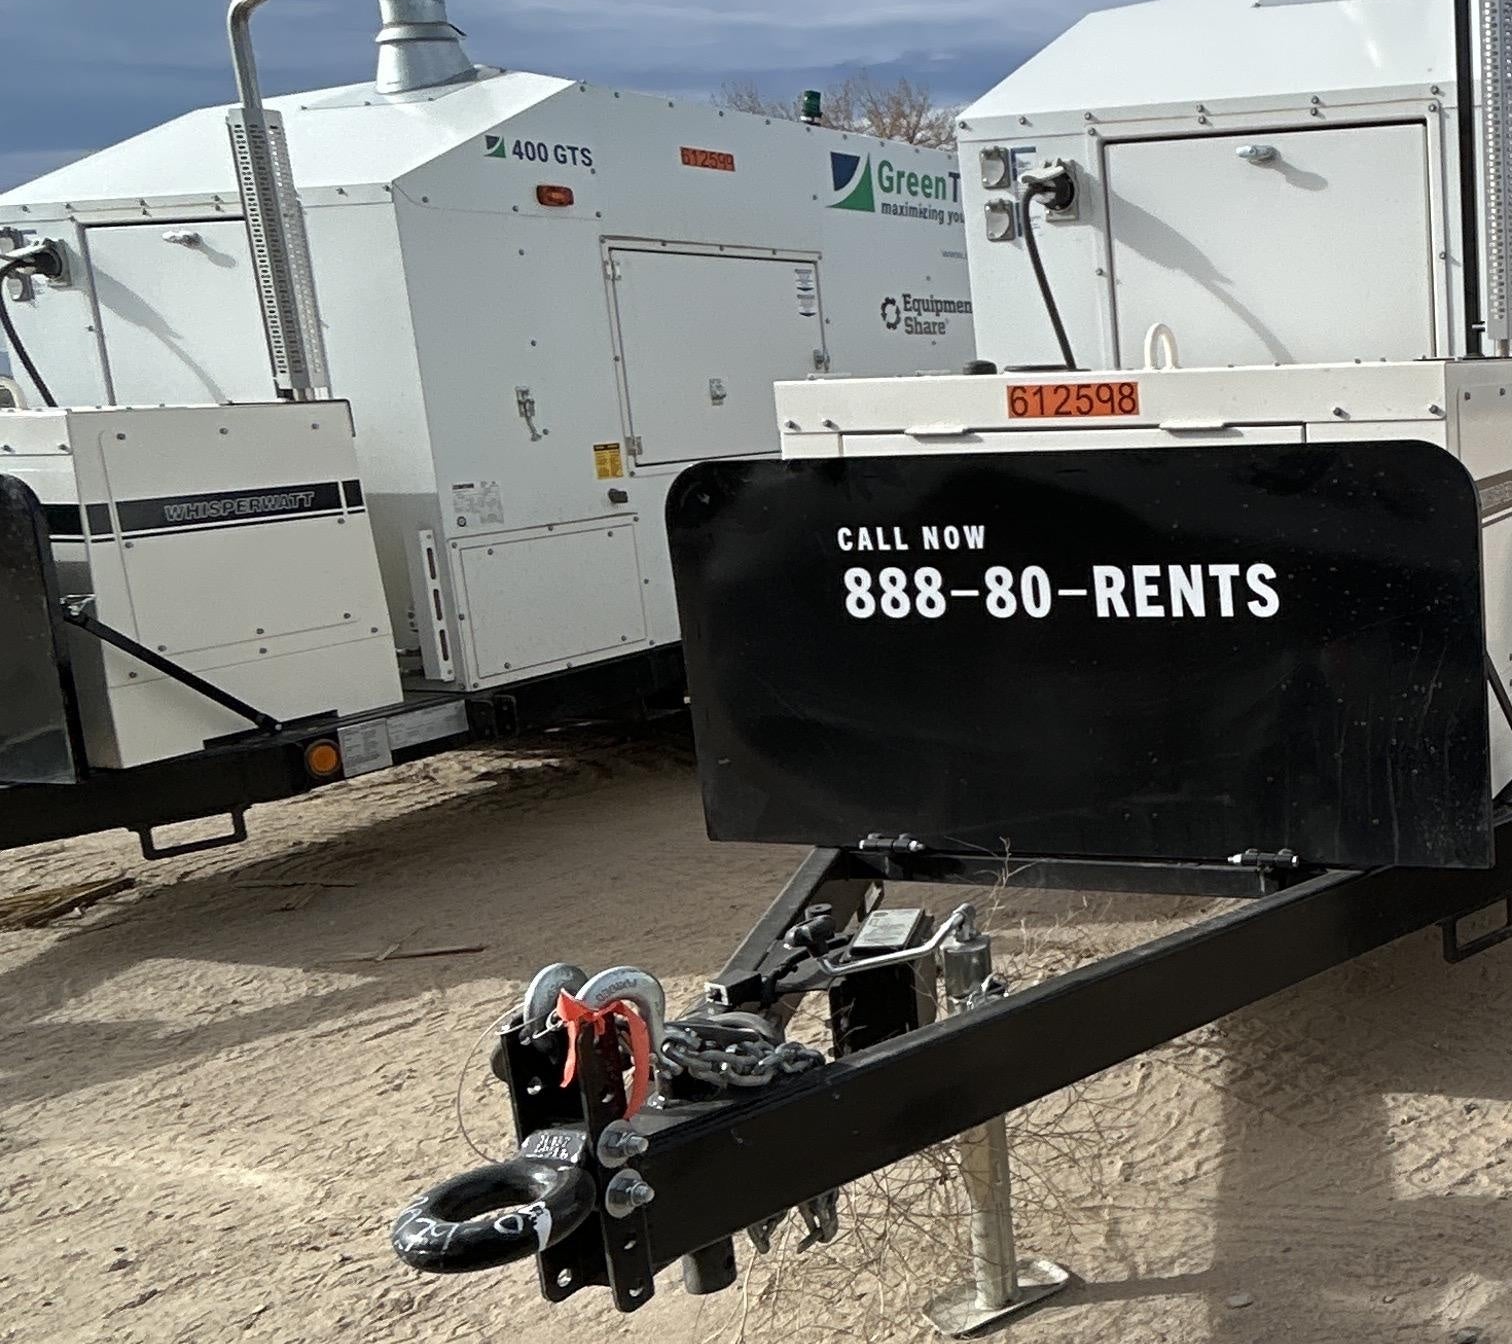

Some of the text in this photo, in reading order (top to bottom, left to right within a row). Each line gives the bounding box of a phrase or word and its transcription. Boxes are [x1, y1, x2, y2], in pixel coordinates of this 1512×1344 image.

[512, 139, 593, 167] 400 GTS
[881, 201, 945, 226] maximizing
[902, 293, 973, 317] Equipmen
[904, 316, 946, 336] Share
[1010, 382, 1137, 417] 612598
[164, 491, 315, 522] WHISPERWATT
[837, 525, 986, 551] CALL NOW
[843, 563, 1281, 619] 888-80-RENTS
